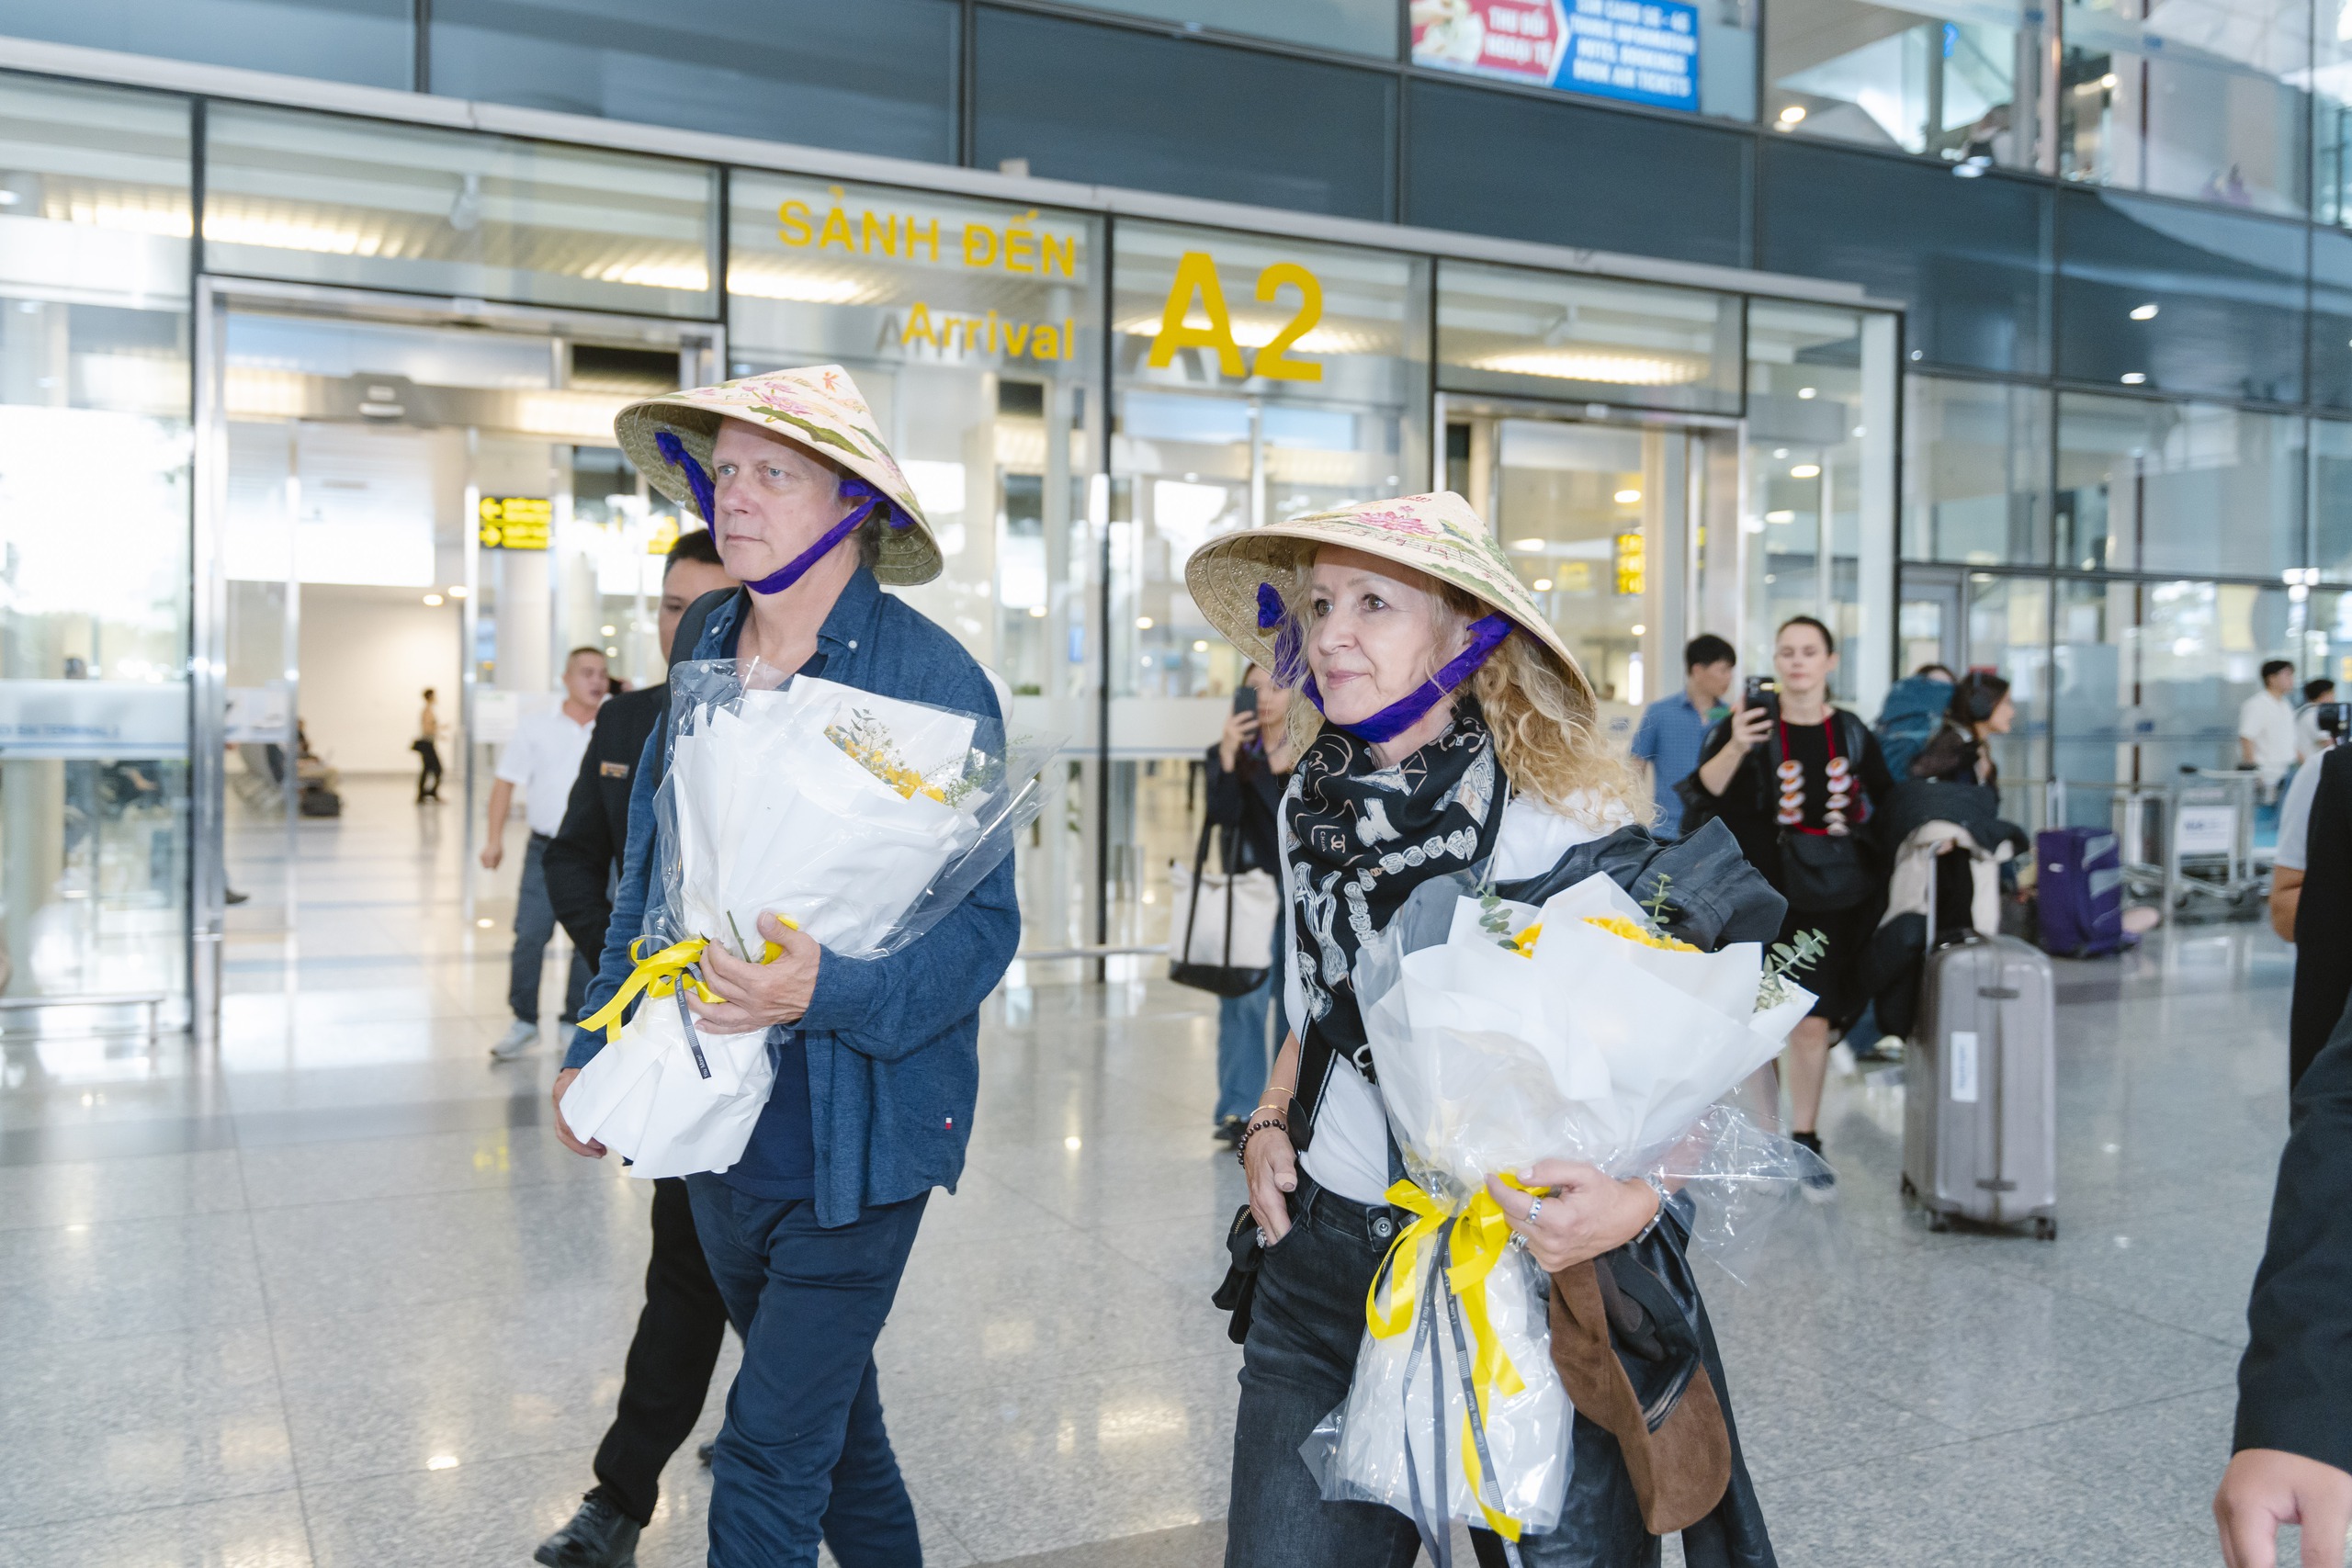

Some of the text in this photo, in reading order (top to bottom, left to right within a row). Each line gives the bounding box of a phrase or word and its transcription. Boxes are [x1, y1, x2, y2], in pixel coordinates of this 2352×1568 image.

[777, 186, 1076, 279] SẢNH ĐẾN
[899, 301, 1076, 361] Arrival
[1147, 250, 1324, 383] A2
